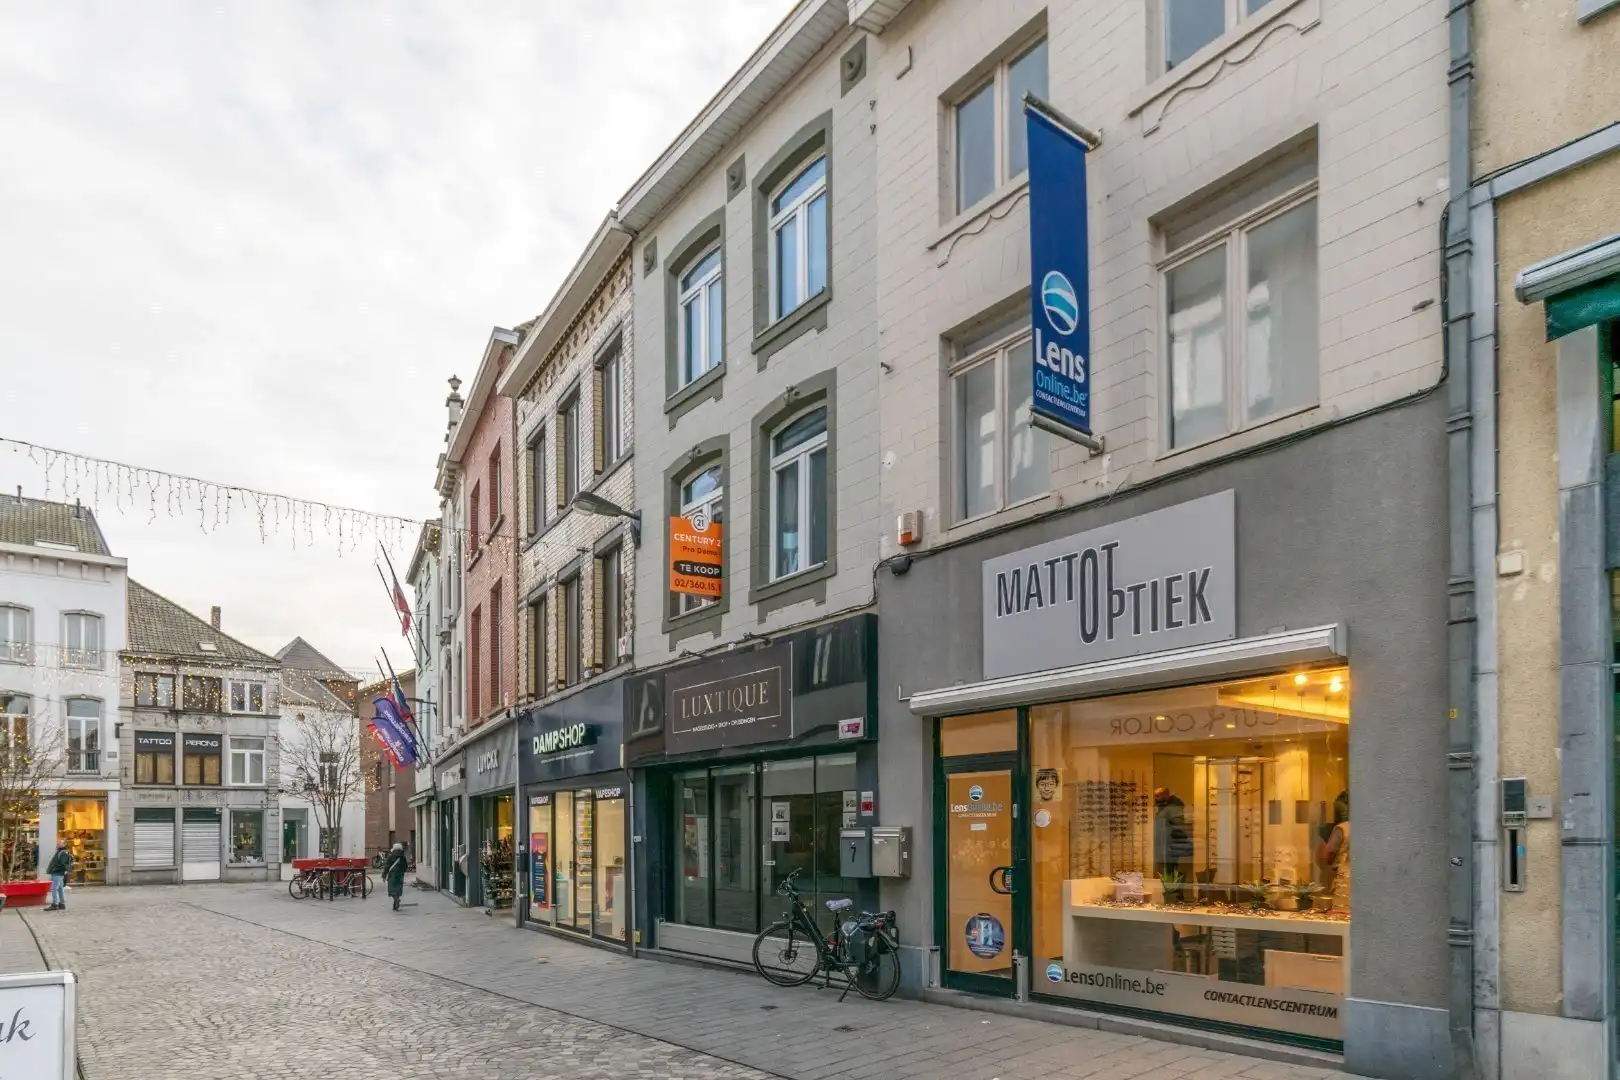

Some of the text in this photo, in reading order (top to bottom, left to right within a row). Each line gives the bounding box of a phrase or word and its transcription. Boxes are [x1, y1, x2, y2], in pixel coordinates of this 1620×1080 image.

[1035, 327, 1085, 384] Lens
[1036, 369, 1088, 407] Online.be
[1035, 389, 1086, 417] CONTACTLENSCENTRUM
[673, 532, 714, 546] CENTURY
[682, 545, 695, 553] Pro
[680, 563, 720, 576] TE KOOP
[996, 541, 1120, 644] MATTOT
[1079, 547, 1213, 644] OPTIEK
[682, 681, 769, 719] LUXTIQUE
[533, 722, 586, 755] DAMPSHOP
[595, 787, 621, 799] VAPESHOP
[849, 846, 857, 862] 7
[1064, 967, 1166, 996] LensOnline.be
[1203, 989, 1338, 1019] CONTACTLENSCENTRUM
